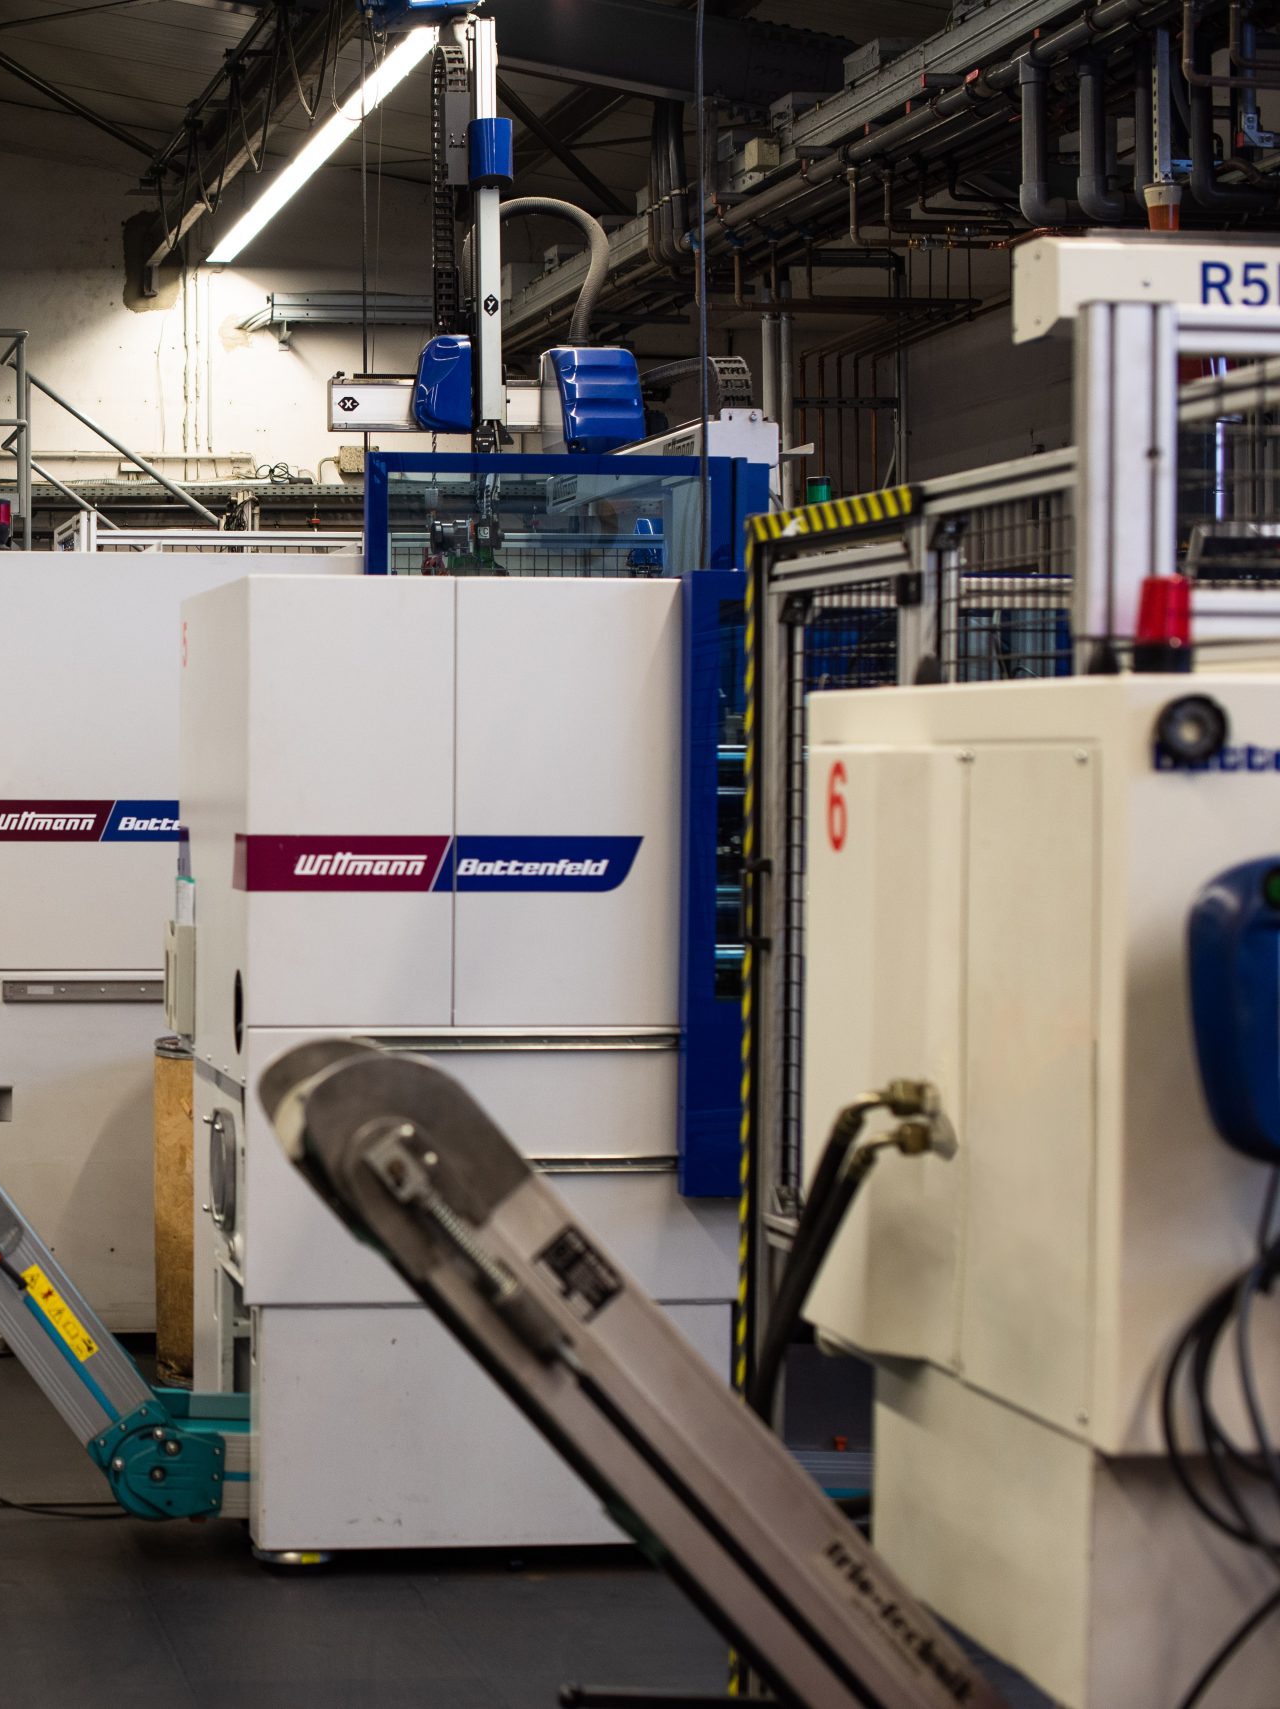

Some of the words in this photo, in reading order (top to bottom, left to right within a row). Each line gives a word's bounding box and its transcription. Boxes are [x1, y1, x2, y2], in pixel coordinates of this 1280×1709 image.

[1201, 261, 1280, 306] R5
[827, 760, 848, 852] 6
[294, 852, 428, 876] Wittmann
[457, 858, 609, 876] Battenfeld
